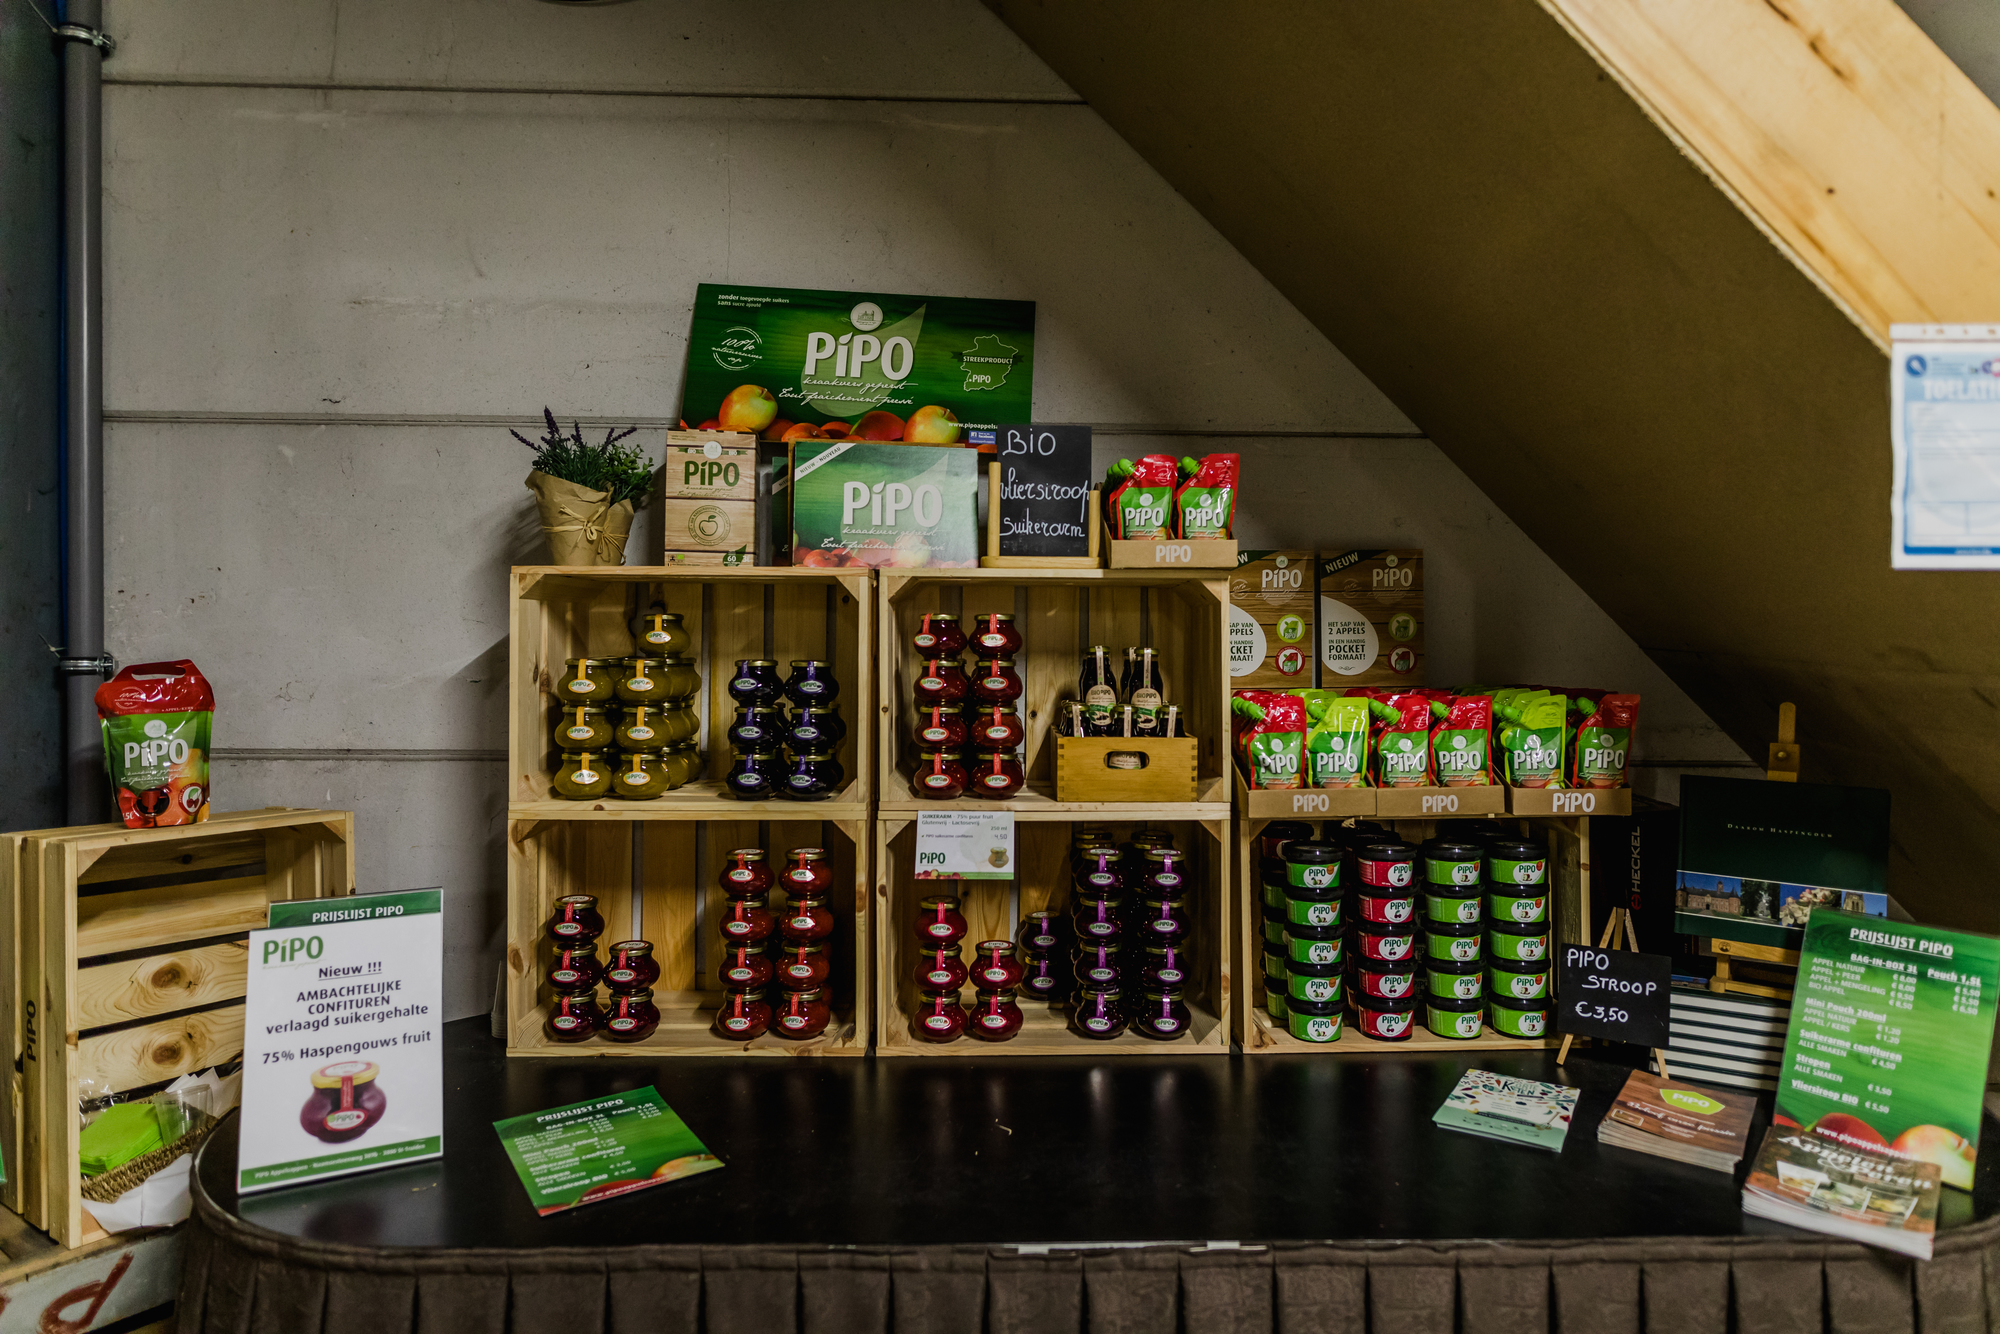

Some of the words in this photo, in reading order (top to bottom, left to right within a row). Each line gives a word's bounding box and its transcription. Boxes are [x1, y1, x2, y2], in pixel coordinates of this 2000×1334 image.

[717, 293, 739, 301] zonder
[962, 355, 1014, 365] STREEKPRODUCT
[802, 376, 864, 388] kraakvers
[800, 462, 816, 474] NIEUW
[1324, 551, 1359, 574] NIEUW
[1230, 628, 1254, 636] PPELS
[1328, 627, 1333, 635] 2
[1336, 627, 1366, 635] APPELS
[1230, 645, 1254, 655] CKET
[1230, 654, 1254, 662] MAAT!
[1328, 644, 1366, 654] POCKET
[1328, 653, 1366, 661] FORMAAT!
[1631, 825, 1640, 893] HECKEL
[311, 907, 372, 923] PRIJSLIJST
[375, 904, 404, 917] PIPO
[1849, 927, 1916, 951] PRIJSLIJST
[1919, 939, 1954, 957] PIPO
[1566, 948, 1610, 971] PIPO
[1812, 957, 1834, 968] APPEL
[1835, 961, 1865, 973] NATUUR
[1850, 953, 1905, 971] BAG-IN-BOX
[318, 963, 363, 979] Nieuw
[367, 961, 383, 973] !!!
[1811, 965, 1833, 976] APPEL
[1841, 971, 1861, 981] PEER
[1927, 967, 1958, 981] Pouch
[296, 979, 402, 1003] AMBACHTELIJKE
[1581, 974, 1658, 996] STROOP
[1808, 981, 1822, 990] BIO
[1822, 984, 1845, 995] APPEL
[1809, 973, 1832, 984] APPEL
[1840, 980, 1886, 996] MENGELING
[307, 995, 391, 1016] CONFITUREN
[1805, 997, 1825, 1009] Mini
[1827, 1001, 1854, 1015] Pouch
[1856, 1008, 1887, 1023] 200ml
[266, 1011, 331, 1035] verlaagd
[333, 1004, 429, 1027] suikergehalte
[1802, 1015, 1825, 1027] APPEL
[1831, 1022, 1850, 1033] KERS
[1803, 1007, 1825, 1018] APPEL
[1827, 1012, 1857, 1026] NATUUR
[262, 1050, 295, 1065] 75%
[299, 1035, 398, 1060] Haspengouws
[402, 1030, 432, 1045] fruit
[1798, 1039, 1815, 1049] ALLE
[1816, 1043, 1847, 1057] SMAKEN
[1799, 1028, 1851, 1049] Suikerarme
[1853, 1043, 1902, 1062] confituren
[1795, 1053, 1831, 1071] Stropen
[1793, 1064, 1811, 1074] ALLE
[1812, 1068, 1843, 1083] SMAKEN
[1841, 1093, 1859, 1105] BIO
[536, 1105, 593, 1123] PRIJSLIJST
[596, 1098, 624, 1109] PIPO
